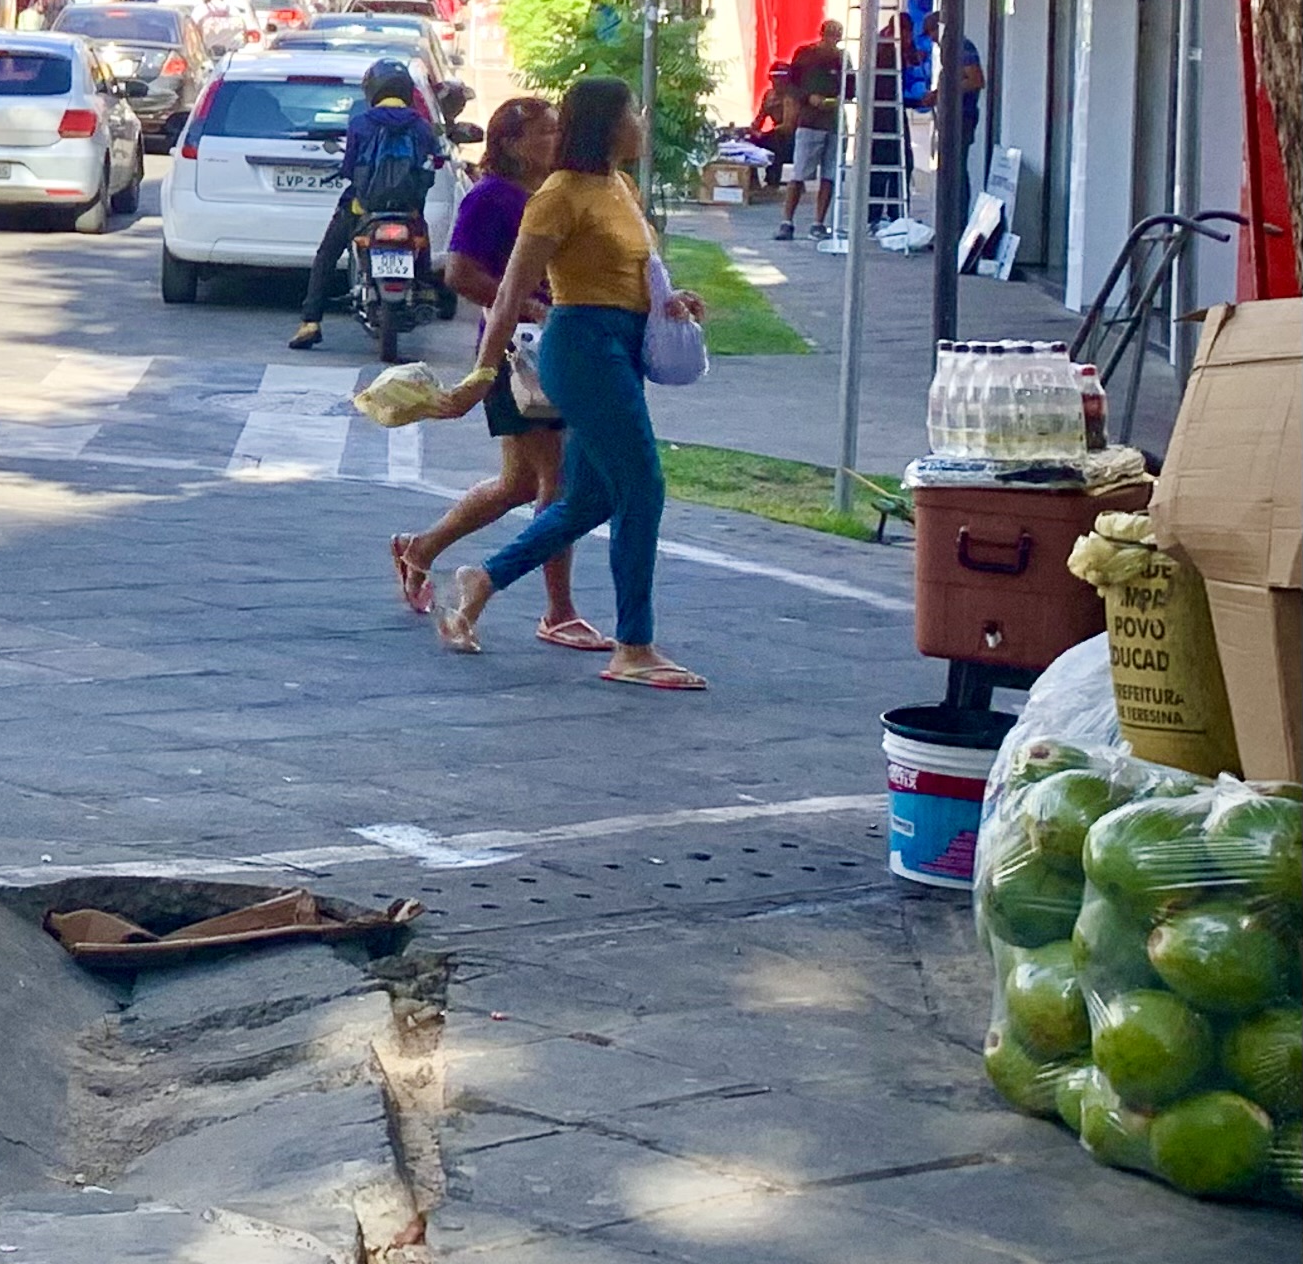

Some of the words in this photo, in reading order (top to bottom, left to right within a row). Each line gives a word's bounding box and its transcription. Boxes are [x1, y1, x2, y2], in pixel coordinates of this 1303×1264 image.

[1114, 615, 1166, 640] POVO
[1110, 645, 1170, 672] DUCAD
[1116, 683, 1185, 706] REFEITURA
[1127, 706, 1184, 725] TERESINA
